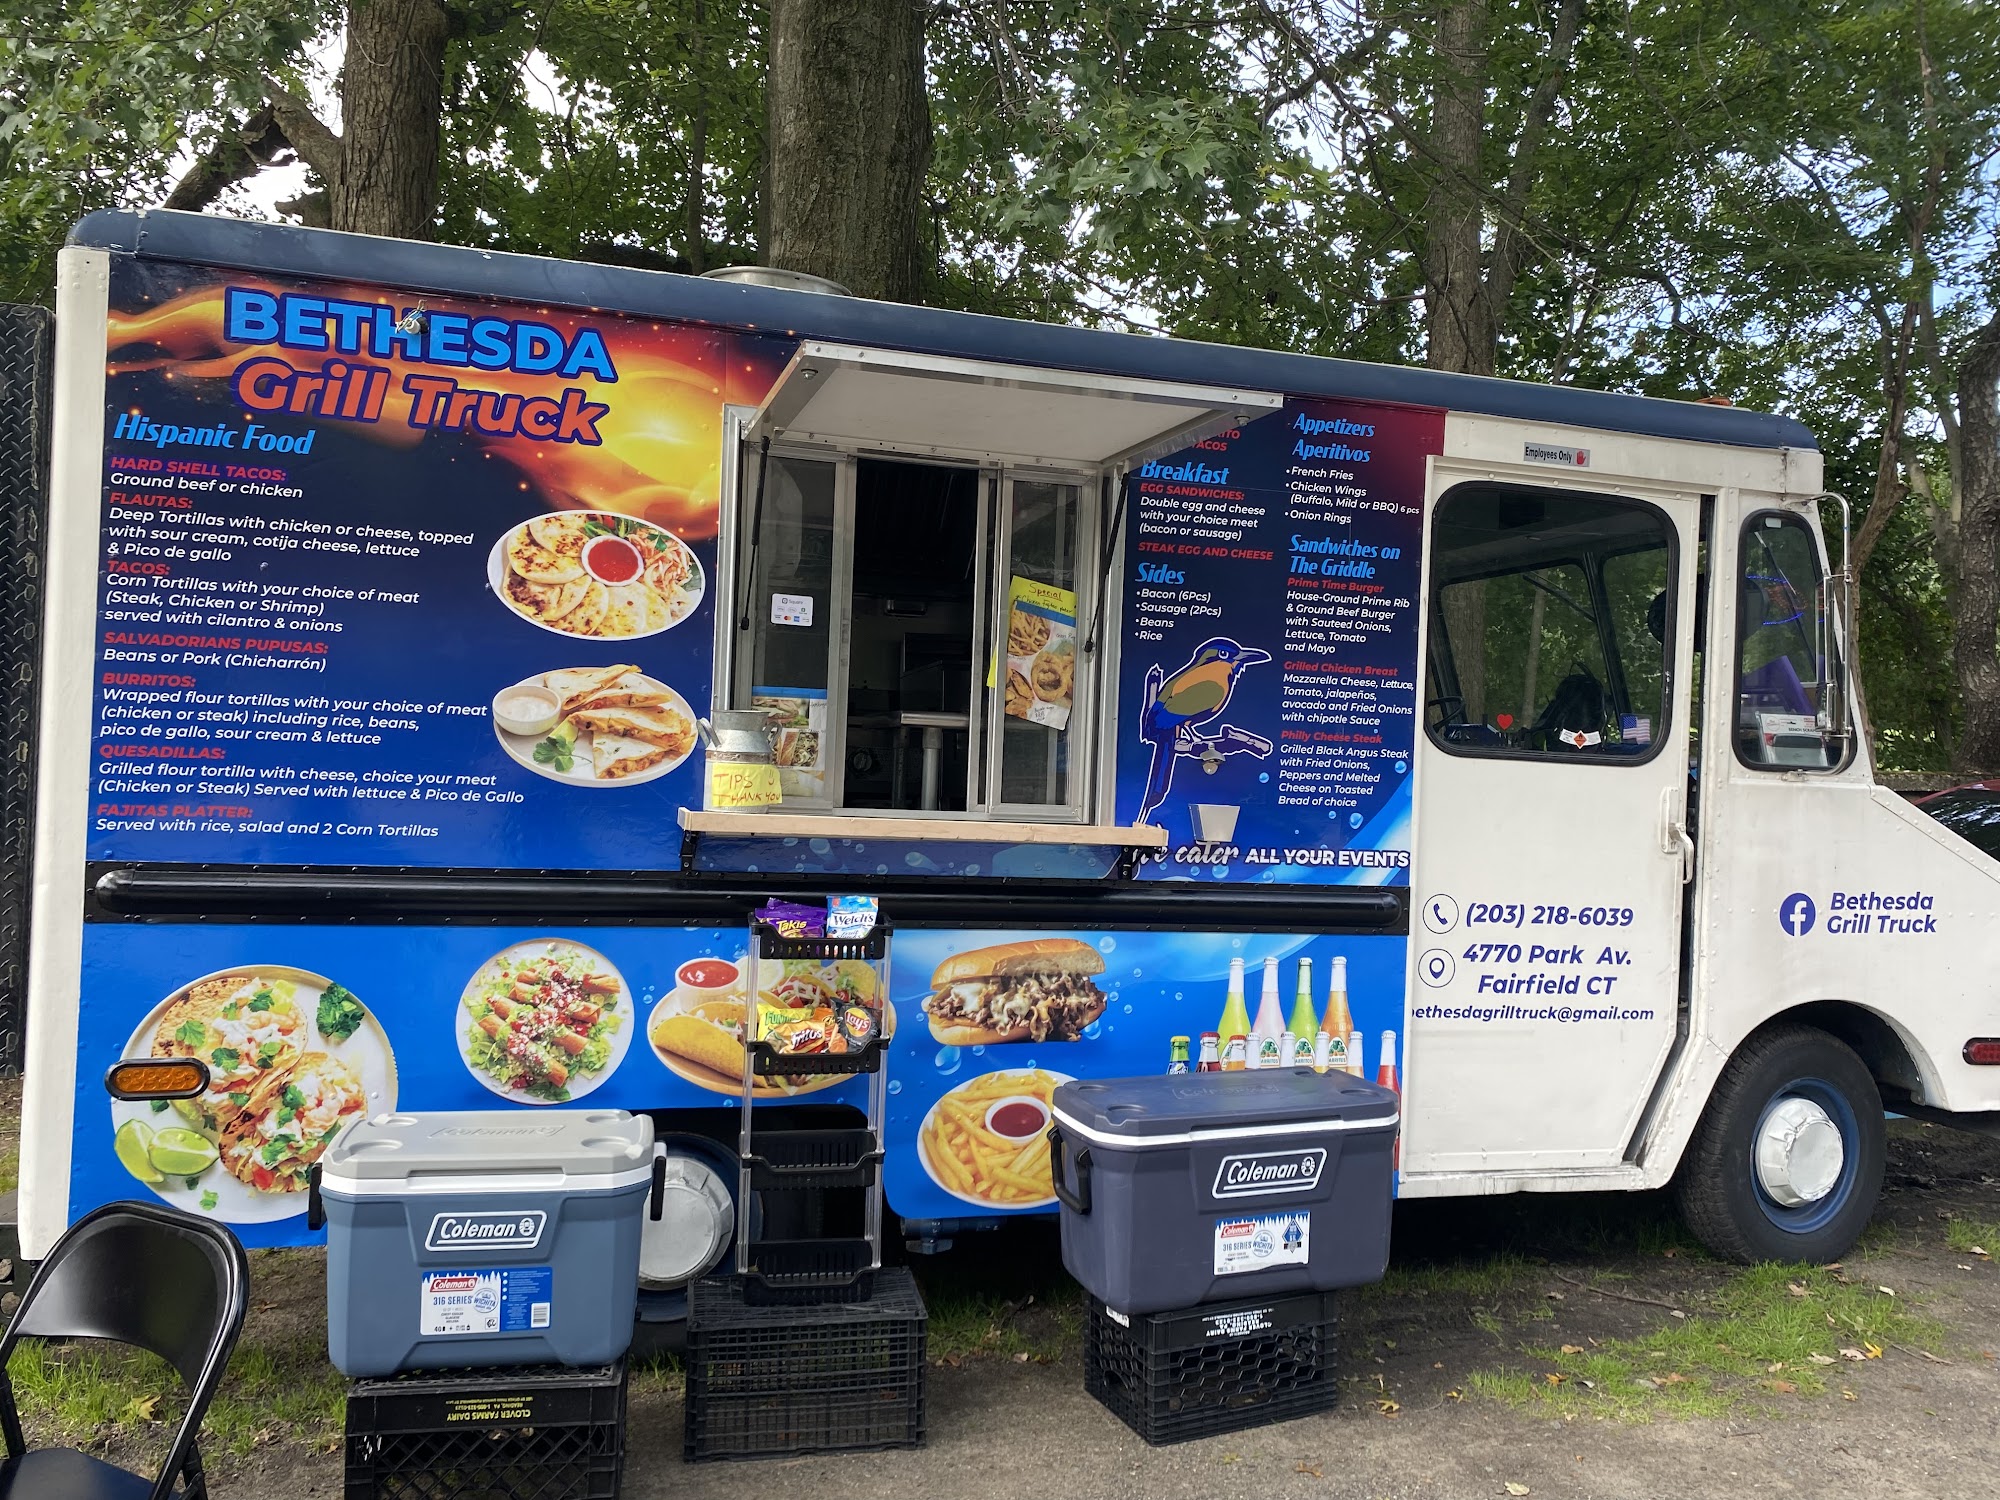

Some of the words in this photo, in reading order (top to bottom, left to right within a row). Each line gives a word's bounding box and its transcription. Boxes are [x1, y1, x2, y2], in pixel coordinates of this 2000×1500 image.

[227, 287, 616, 380] BETHESDA
[236, 360, 390, 423] Grill
[402, 375, 610, 443] Truck
[1292, 412, 1376, 438] Appetizers
[113, 413, 241, 451] Hispanic
[242, 424, 316, 456] Food
[1291, 439, 1372, 463] Aperitivos
[1525, 446, 1558, 461] Employees
[1558, 450, 1573, 464] Only
[111, 457, 163, 471] HARD
[166, 461, 220, 476] SHELL
[226, 465, 286, 481] TACOS:
[1140, 460, 1230, 485] Breakfast
[1291, 466, 1327, 478] French
[1329, 470, 1354, 480] Fries
[111, 473, 174, 488] Ground
[178, 477, 217, 491] beef
[219, 483, 237, 492] or
[240, 482, 303, 498] chicken
[1140, 483, 1164, 493] EGG
[1166, 485, 1244, 500] SANDWICHES:
[1291, 481, 1332, 493] Chicken
[1335, 485, 1367, 498] Wings
[110, 492, 193, 509] FLAUTAS:
[1140, 496, 1179, 508] Double
[1182, 502, 1203, 512] egg
[1205, 503, 1227, 512] and
[1229, 504, 1265, 515] cheese
[109, 507, 154, 523] Deep
[159, 510, 225, 526] Tortillas
[229, 516, 265, 529] with
[269, 519, 331, 534] chicken
[335, 526, 353, 535] or
[356, 525, 413, 542] cheese,
[418, 530, 474, 545] topped
[1290, 510, 1321, 520] Onion
[1323, 512, 1351, 525] Rings
[1139, 542, 1175, 553] STEAK
[1178, 545, 1201, 555] EGG
[1202, 547, 1228, 557] AND
[1230, 549, 1274, 560] CHEESE
[1288, 534, 1378, 559] Sandwiches
[1380, 546, 1402, 560] on
[107, 560, 170, 575] TACOS:
[1135, 562, 1186, 585] Sides
[1290, 556, 1318, 575] The
[1321, 557, 1376, 580] Griddle
[107, 573, 146, 587] Corn
[152, 576, 218, 591] Tortillas
[222, 580, 258, 593] with
[260, 585, 299, 596] your
[302, 585, 354, 599] choice
[358, 589, 376, 600] of
[377, 592, 420, 603] meat
[1028, 582, 1063, 601] Special
[1287, 577, 1319, 588] Prime
[1322, 579, 1347, 590] Time
[1348, 582, 1384, 594] Burger
[106, 590, 163, 607] (Steak,
[169, 594, 235, 609] Chicken
[239, 601, 257, 610] or
[260, 599, 324, 617] Shrimp)
[1141, 588, 1176, 599] Bacon
[1179, 590, 1211, 604] (6Pcs)
[1140, 602, 1187, 615] Sausage
[1190, 605, 1221, 618] (2Pcs)
[1140, 617, 1174, 628] Beans
[104, 632, 241, 649] SALVADORIANS
[245, 639, 328, 654] PUPUSAS:
[1139, 630, 1163, 640] Rice
[103, 648, 157, 662] Beans
[161, 653, 179, 663] or
[182, 652, 222, 665] Pork
[225, 653, 326, 673] (Chicharrón)
[1284, 661, 1319, 671] Grilled
[1321, 663, 1362, 674] Chicken
[1364, 666, 1398, 676] Breast
[102, 672, 196, 687] BURRITOS:
[103, 688, 182, 704] Wrapped
[185, 691, 224, 704] flour
[228, 694, 290, 707] tortillas
[294, 696, 329, 708] with
[331, 700, 370, 712] your
[372, 699, 423, 713] choice
[427, 702, 445, 714] of
[446, 706, 488, 716] meat
[1281, 730, 1311, 742] Philly
[1313, 732, 1351, 742] Cheese
[1352, 734, 1382, 743] Steak
[99, 744, 226, 759] QUESADILLAS:
[99, 762, 154, 775] Grilled
[158, 763, 197, 776] flour
[201, 765, 255, 777] tortilla
[260, 766, 295, 779] with
[300, 768, 358, 783] cheese,
[363, 770, 414, 783] choice
[415, 774, 453, 786] your
[455, 775, 497, 786] meat
[713, 773, 754, 790] TIPS
[712, 792, 762, 808] THANK
[765, 792, 781, 803] YOU
[97, 804, 168, 817] FAJITAS
[172, 805, 253, 818] PLATTER:
[96, 818, 155, 830] Served
[159, 819, 196, 831] with
[200, 822, 234, 834] rice,
[238, 820, 284, 833] salad
[287, 822, 320, 834] and
[322, 823, 332, 834] 2
[336, 823, 373, 835] Corn
[378, 824, 439, 837] Tortillas
[1175, 840, 1240, 865] cater
[1244, 848, 1280, 864] ALL
[1283, 849, 1335, 866] YOUR
[1338, 850, 1410, 868] EVENTS
[1830, 891, 1934, 910] Bethesda
[833, 913, 874, 926] Welch's
[1466, 903, 1525, 928] (203)
[1531, 905, 1633, 926] 218-6039
[1827, 913, 1871, 934] Grill
[1877, 914, 1937, 933] Truck
[776, 919, 807, 935] Takis
[1462, 944, 1522, 963] 4770
[1528, 945, 1584, 964] Park
[1596, 947, 1631, 965] Av.
[1478, 973, 1581, 994] Fairfield
[1587, 976, 1617, 995] CT
[846, 1013, 870, 1031] Lay's
[1226, 1160, 1299, 1185] Coleman
[440, 1218, 517, 1240] Coleman
[1222, 1225, 1249, 1236] Coleman
[1233, 1241, 1252, 1251] SERIES
[433, 1279, 468, 1290] Coleman
[433, 1296, 445, 1306] 316
[447, 1295, 472, 1305] SERIES
[446, 1412, 470, 1421] DAIRY
[471, 1411, 499, 1420] FARMS
[501, 1409, 531, 1419] CLOVER
